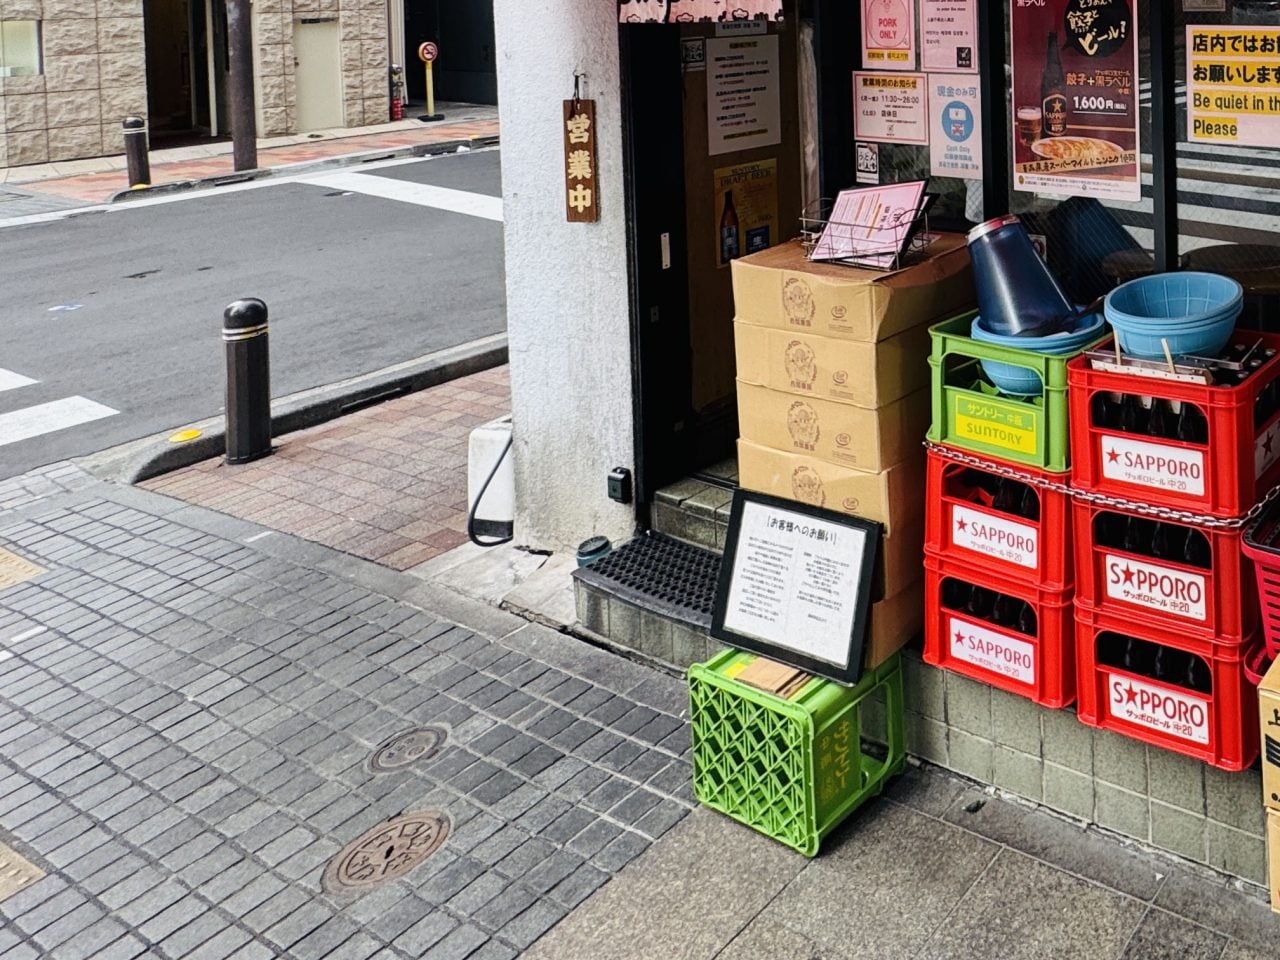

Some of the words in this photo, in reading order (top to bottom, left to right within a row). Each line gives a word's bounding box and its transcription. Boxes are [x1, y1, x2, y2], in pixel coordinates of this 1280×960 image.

[878, 18, 897, 27] PORK
[879, 31, 897, 39] ONLY
[862, 78, 917, 89] 営業時間のお知らせ
[937, 85, 977, 99] 現金のみ可
[1193, 92, 1210, 108] Be
[1215, 94, 1248, 110] quiet
[1253, 95, 1264, 110] in
[1193, 119, 1238, 136] Please
[566, 113, 592, 213] 営業中
[967, 403, 1004, 419] サントリー
[966, 422, 1023, 445] SUNTORY
[1124, 451, 1200, 480] SAPPORO
[971, 521, 1034, 553] SAPPORO
[1123, 589, 1168, 607] サッポロビール
[968, 635, 1031, 669] SAPPORO
[1126, 709, 1171, 729] サッポロビール
